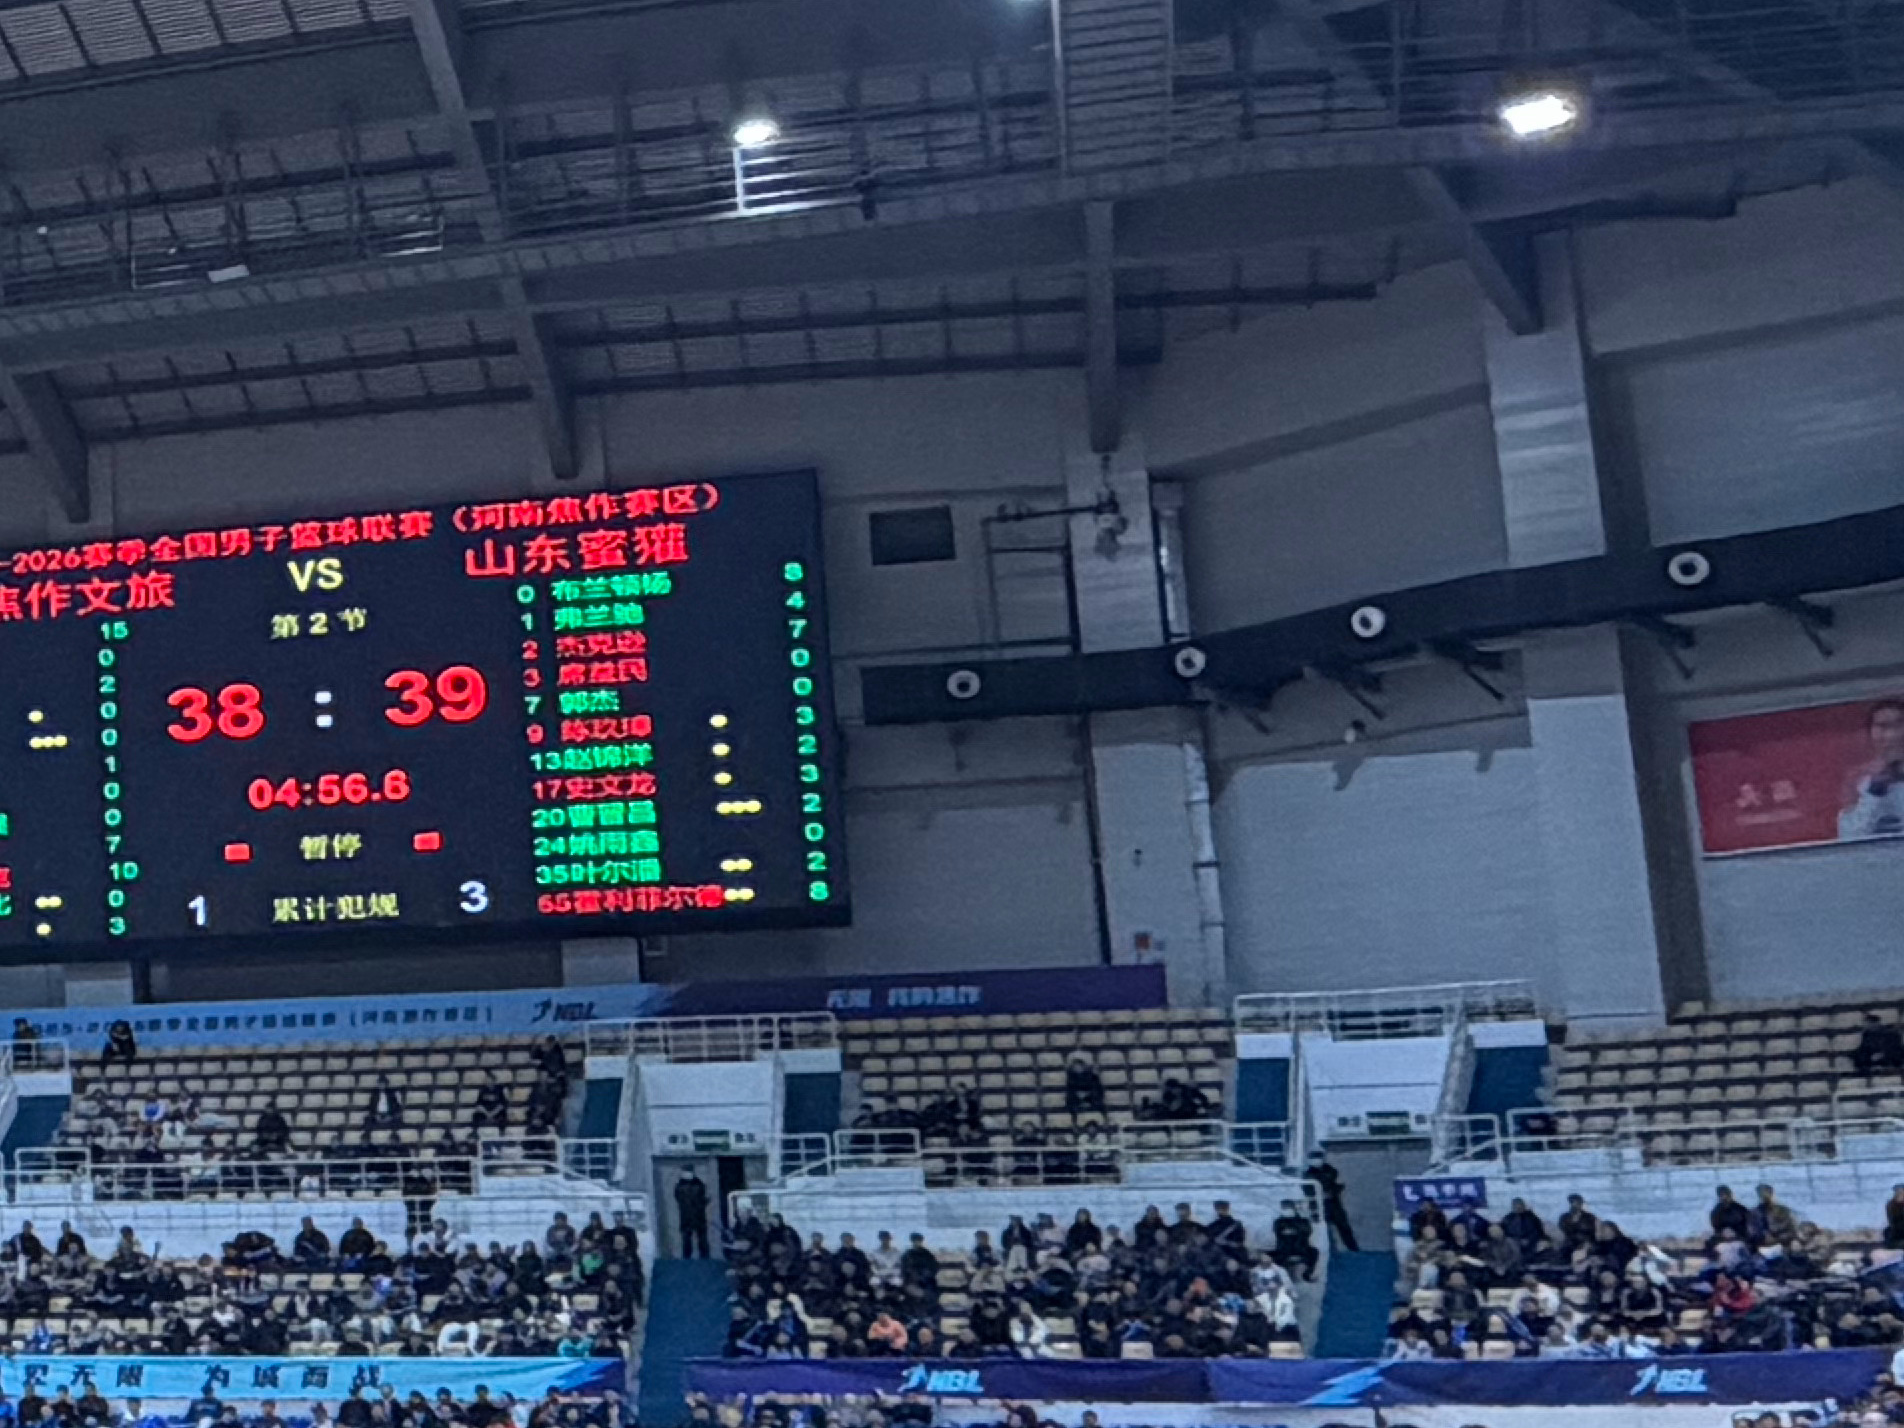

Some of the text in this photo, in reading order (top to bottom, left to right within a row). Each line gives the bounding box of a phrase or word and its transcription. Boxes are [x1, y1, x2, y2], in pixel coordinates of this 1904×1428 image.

[464, 522, 690, 579] 山东蜜獾
[285, 558, 344, 593] VS
[516, 584, 535, 604] 0
[520, 612, 533, 631] 1
[785, 590, 805, 609] 4
[100, 621, 129, 640] 15
[522, 640, 539, 660] 2
[788, 618, 807, 639] 7
[98, 648, 115, 667] 0
[790, 647, 810, 667] 0
[99, 675, 116, 694] 2
[384, 665, 488, 726] 39
[524, 696, 542, 716] 7
[792, 676, 812, 697] 0
[100, 701, 118, 720] 0
[166, 682, 267, 741] 38
[796, 705, 815, 725] 3
[101, 728, 119, 747] 0
[798, 734, 818, 754] 2
[105, 754, 117, 773] 1
[799, 764, 819, 784] 3
[103, 781, 120, 800] 0
[801, 793, 822, 813] 2
[104, 808, 122, 827] 0
[804, 822, 824, 842] 0
[105, 834, 122, 854] 7
[299, 832, 362, 860] 暂停
[108, 861, 139, 881] 10
[806, 851, 827, 872] 2
[107, 888, 125, 908] 0
[273, 892, 400, 922] 累计犯规
[459, 880, 490, 914] 3
[188, 894, 206, 926] 1
[108, 916, 126, 935] 3
[925, 1368, 986, 1394] NBL
